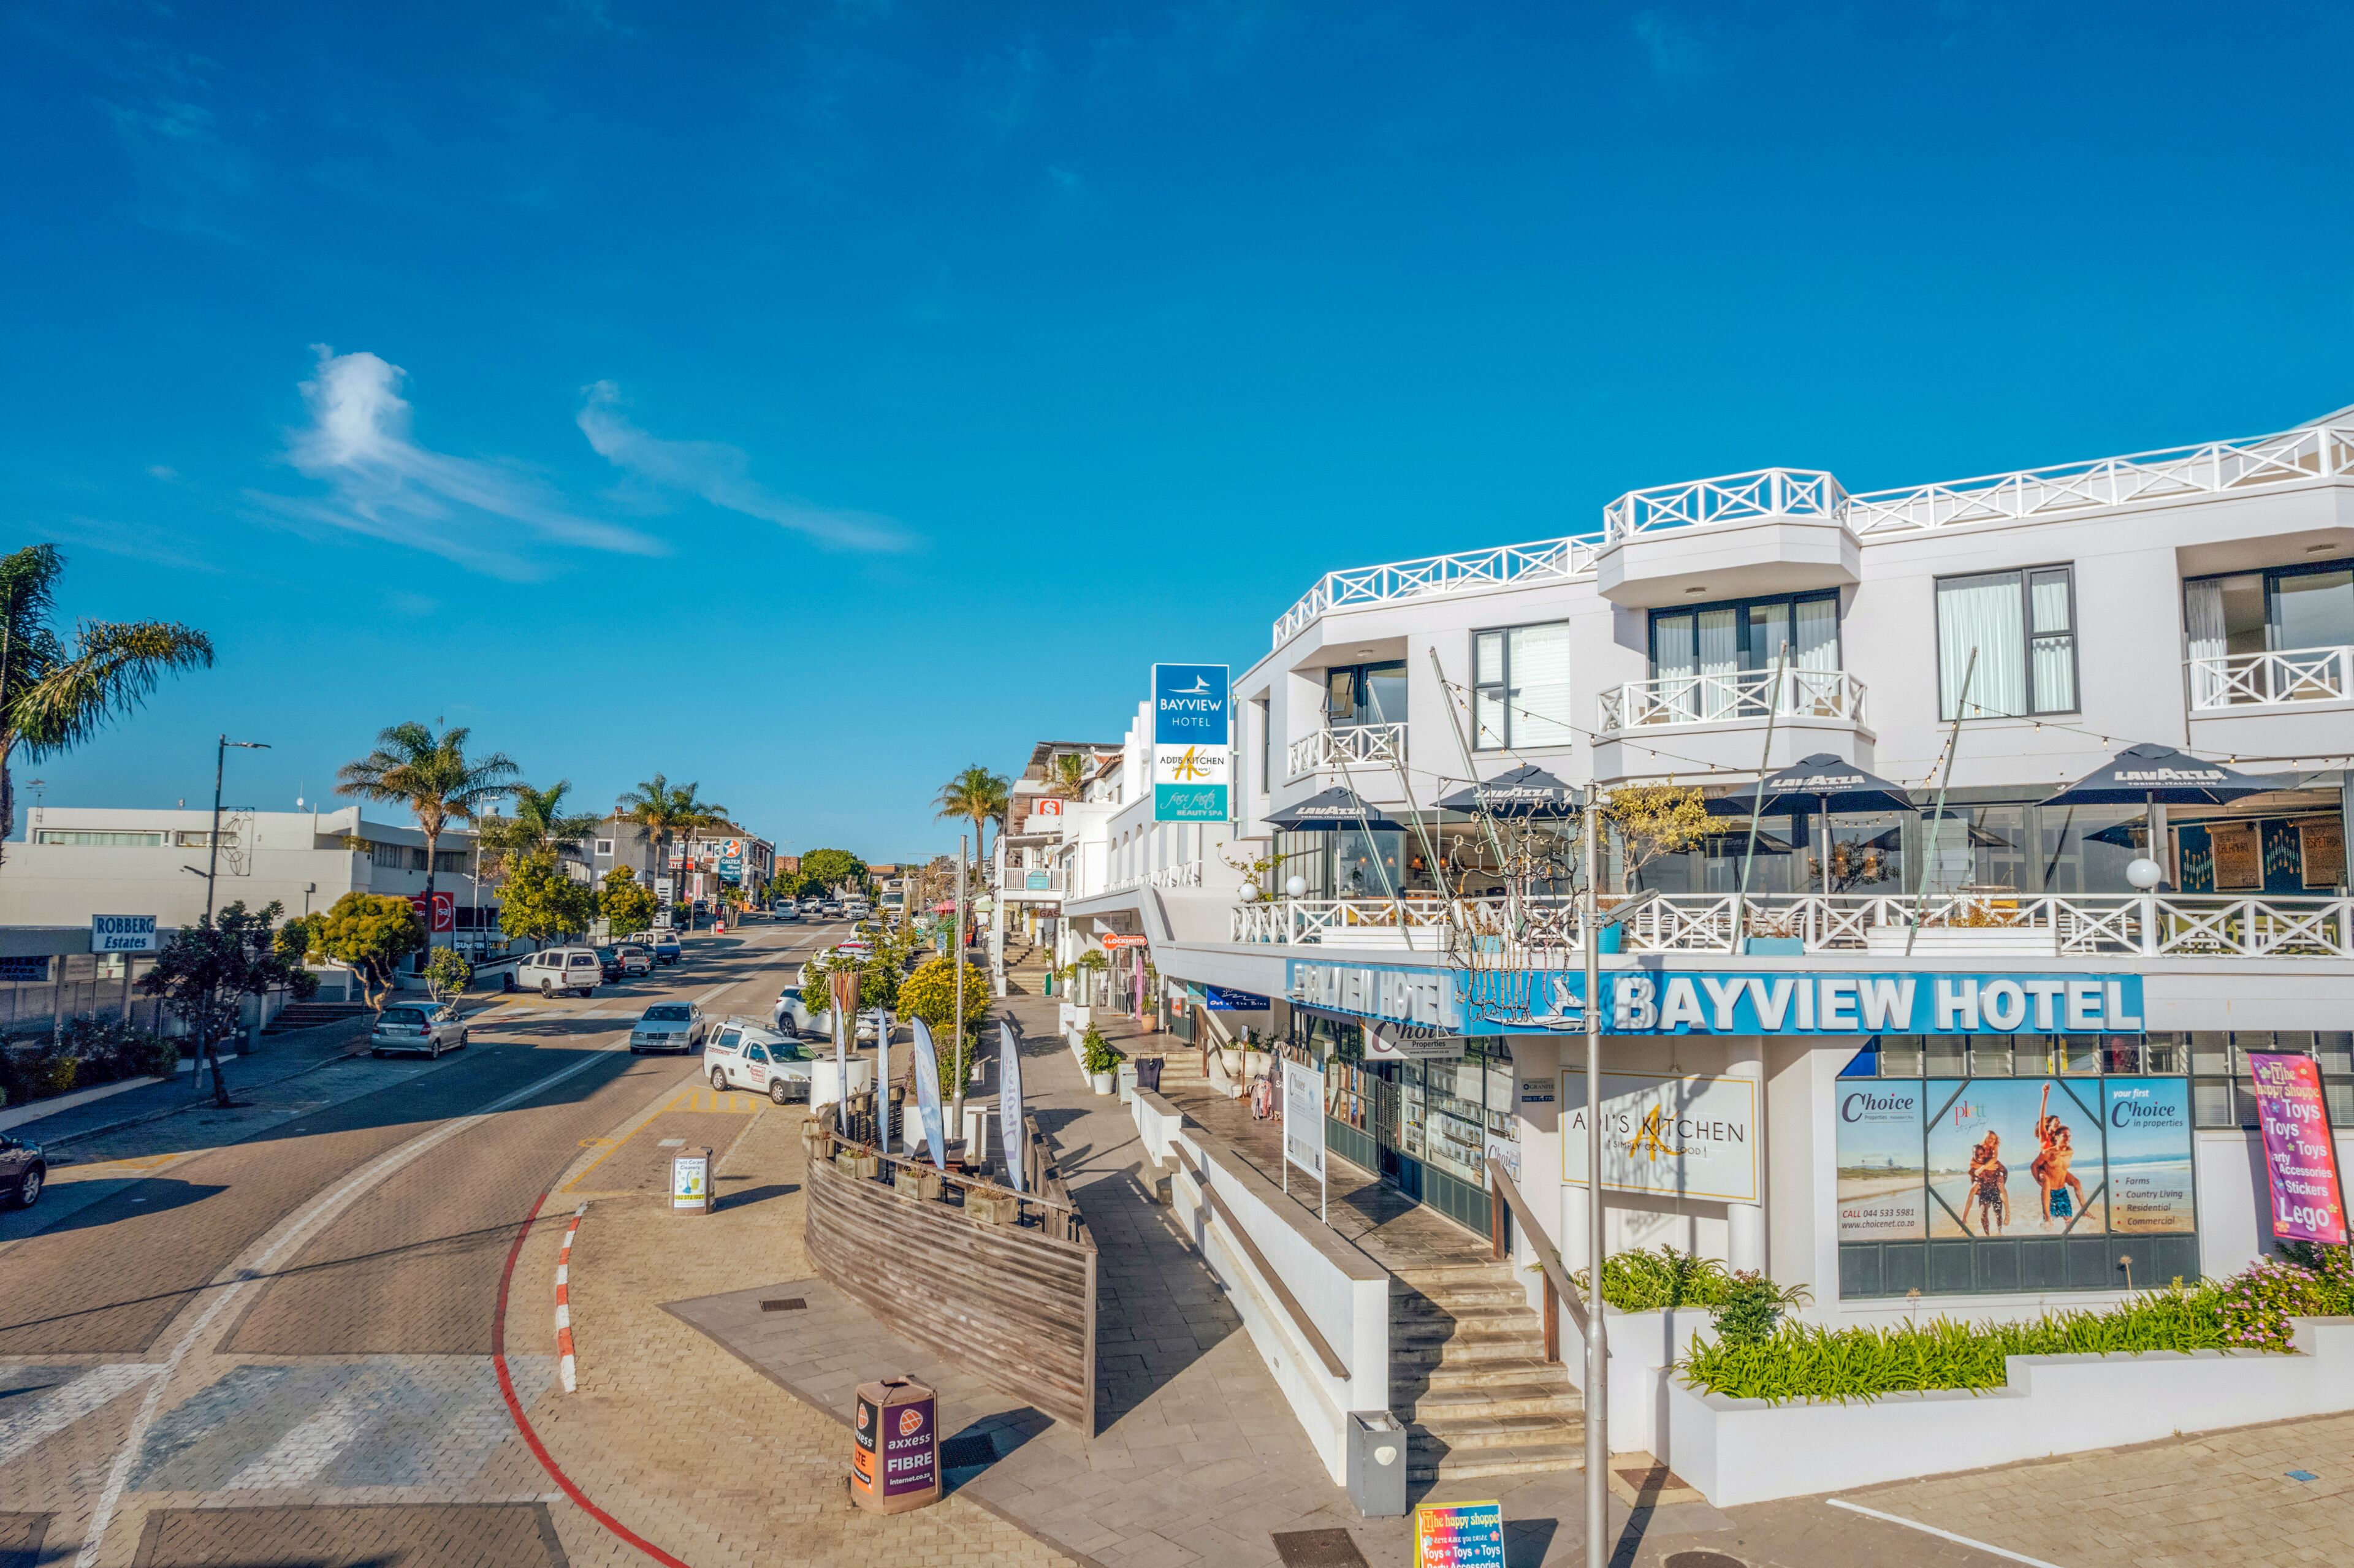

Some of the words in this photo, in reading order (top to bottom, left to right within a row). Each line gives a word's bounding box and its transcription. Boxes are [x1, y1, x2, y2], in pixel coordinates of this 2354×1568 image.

[1160, 698, 1222, 711] BAYVIEW
[1172, 717, 1211, 726] HOTEL
[1187, 756, 1224, 765] KITCHEN
[1769, 775, 1865, 788] LAVAZZA
[2114, 768, 2228, 780] LAVAZZA
[1295, 806, 1366, 815] LAVAZZA
[97, 917, 154, 934] ROBBERG
[104, 936, 147, 949] Estates
[1304, 964, 1377, 1014] BAYVIEW
[1379, 971, 1460, 1028] HOTEL
[1613, 977, 1916, 1030] BAYVIEW
[1935, 979, 2141, 1030] HOTEL
[2269, 1062, 2296, 1085] The
[1290, 1072, 1306, 1096] Choice
[2285, 1083, 2320, 1100] shoppe
[2113, 1090, 2131, 1099] your
[2133, 1089, 2149, 1099] first
[1842, 1092, 1914, 1123] Choice
[1952, 1100, 1987, 1126] plett
[2111, 1101, 2175, 1128] Choice
[2282, 1098, 2320, 1123] Toys
[1572, 1112, 1629, 1133] AI'S
[1642, 1116, 1743, 1143] KITCHEN
[2143, 1119, 2183, 1128] properties
[2266, 1117, 2299, 1140] Toys
[1613, 1141, 1641, 1150] SIMPLY
[1645, 1143, 1671, 1153] GOOD
[1675, 1146, 1701, 1155] FOOD
[2296, 1141, 2327, 1160] Toys
[2272, 1152, 2290, 1165] arty
[2279, 1163, 2333, 1178] Accessories
[2126, 1190, 2158, 1199] Country
[2160, 1190, 2183, 1199] Living
[2285, 1180, 2328, 1197] Stickers
[1895, 1208, 1914, 1217] 5981
[2127, 1203, 2171, 1212] Residential
[2280, 1197, 2329, 1231] Lego
[1842, 1220, 1914, 1228] www.choicenet.co.za
[2127, 1216, 2175, 1225] Commercial
[888, 1433, 931, 1450] axxess
[888, 1451, 932, 1472] FIBRE
[889, 1472, 931, 1486] internet.co.za
[1421, 1510, 1444, 1532] The
[1445, 1514, 1469, 1529] happy
[1470, 1512, 1500, 1528] shoppe
[1423, 1545, 1444, 1561] Toys
[1452, 1545, 1472, 1560] Toys
[1481, 1544, 1501, 1558] Toys
